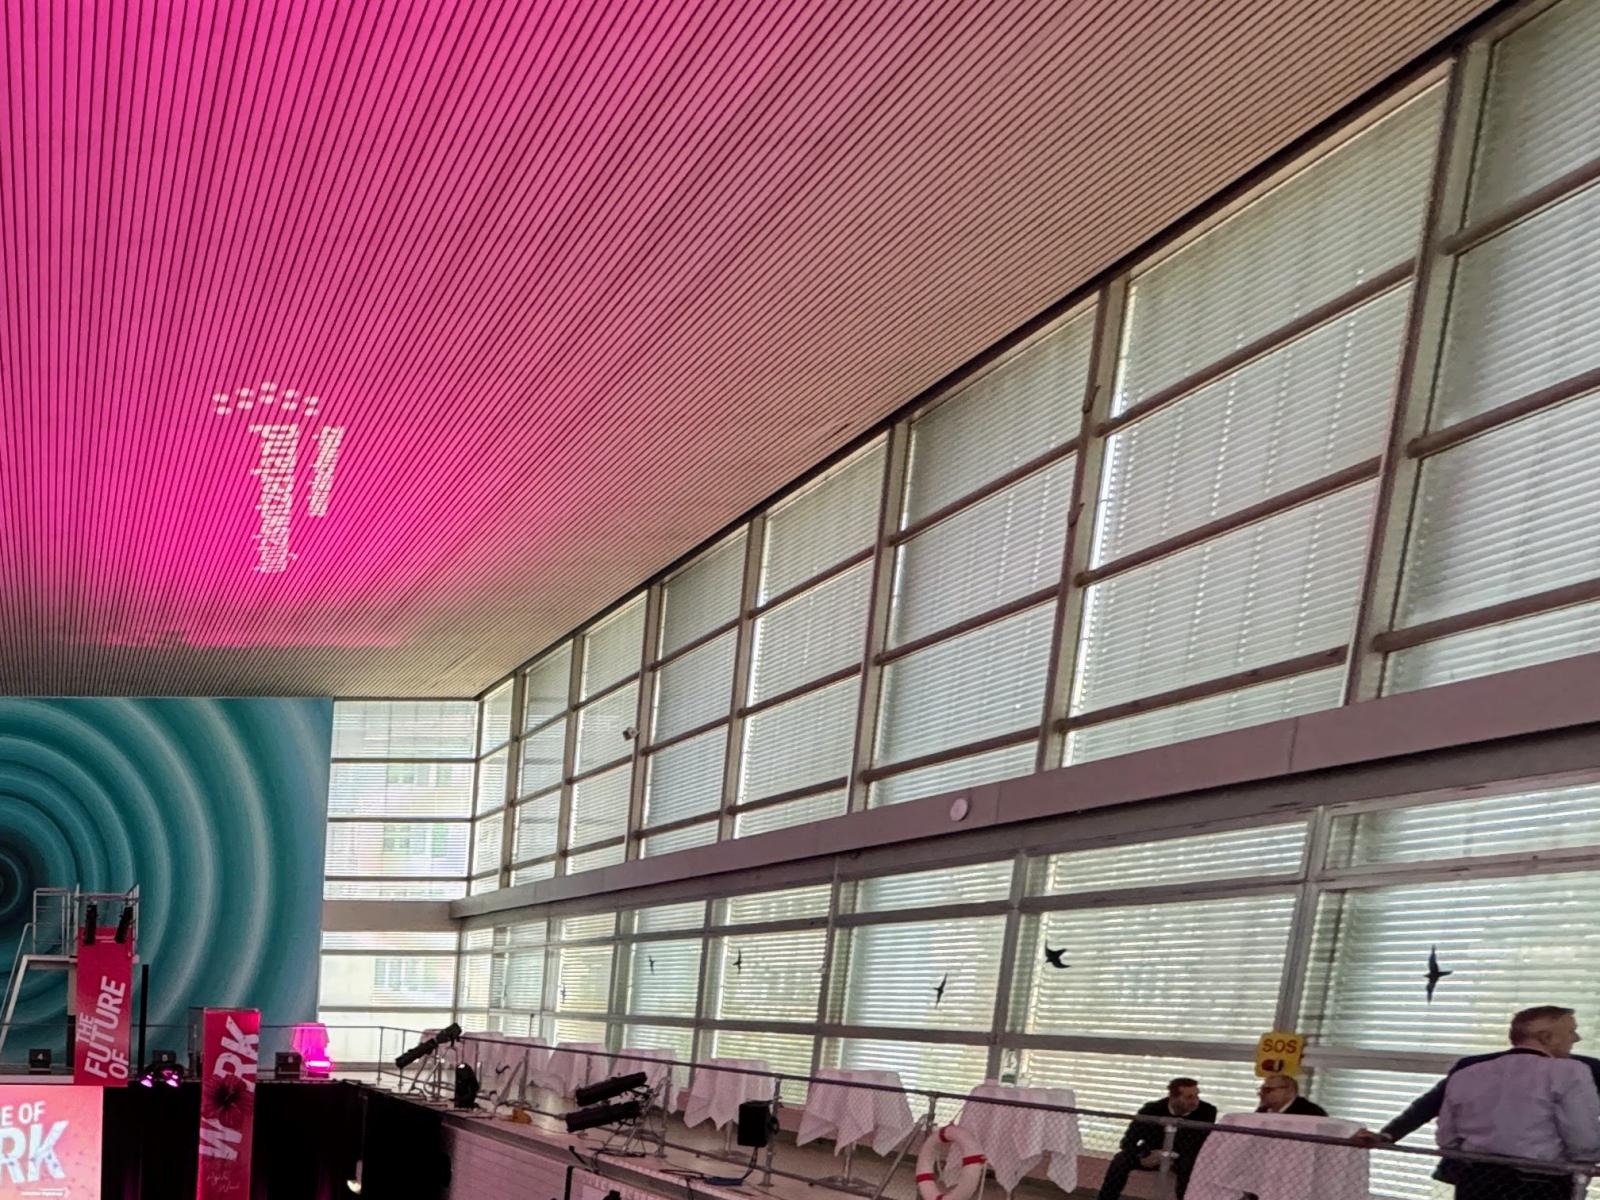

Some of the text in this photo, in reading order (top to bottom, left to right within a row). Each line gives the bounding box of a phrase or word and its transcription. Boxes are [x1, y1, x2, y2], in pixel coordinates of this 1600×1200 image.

[75, 1012, 94, 1043] THE
[84, 975, 126, 1078] FUTURE
[1262, 1038, 1297, 1054] SOS
[108, 1048, 129, 1079] OF
[199, 1015, 259, 1162] WRK
[19, 1101, 46, 1124] OF
